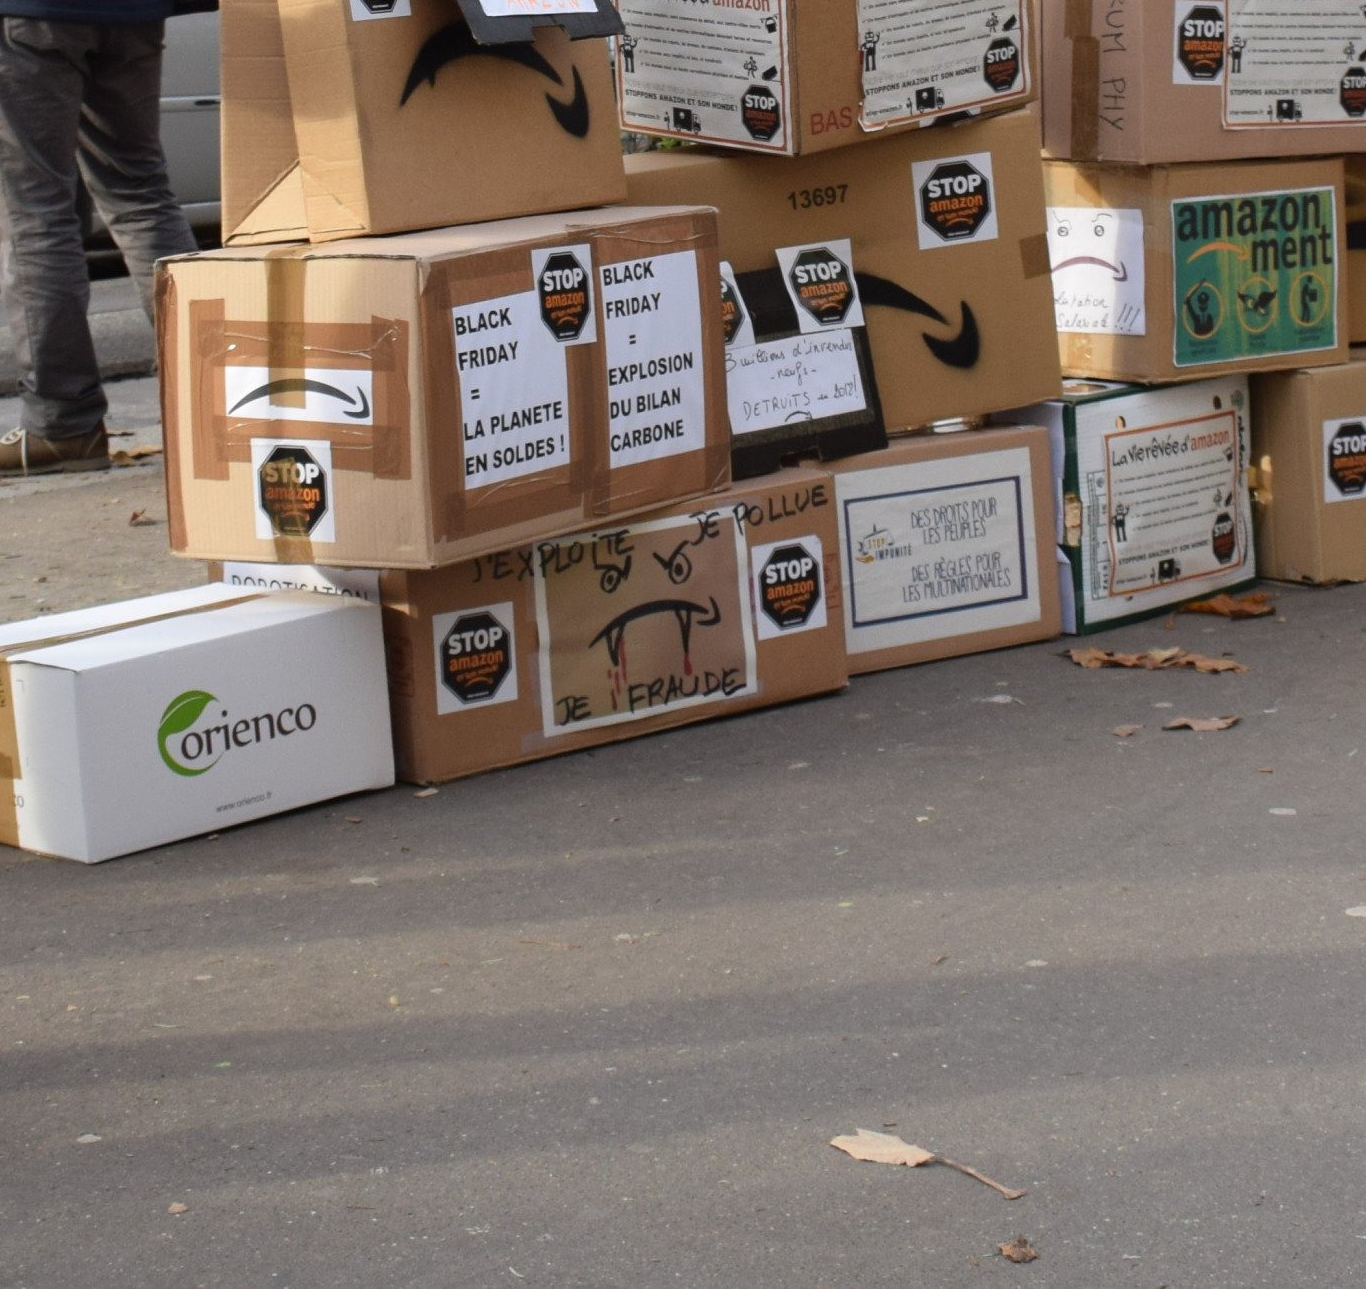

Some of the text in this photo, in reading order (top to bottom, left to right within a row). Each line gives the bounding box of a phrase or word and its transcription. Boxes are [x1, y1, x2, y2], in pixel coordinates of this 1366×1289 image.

[1184, 19, 1224, 38] STOP
[987, 46, 1015, 63] STOP
[745, 95, 775, 110] STOP
[810, 106, 853, 135] BAS
[788, 184, 849, 210] 13697
[927, 174, 981, 198] STOP
[929, 195, 983, 213] amazon
[1177, 194, 1322, 241] amazon
[1250, 224, 1333, 273] ment
[543, 268, 583, 291] STOP
[602, 260, 654, 286] BLACK
[795, 262, 841, 284] STOP
[545, 292, 585, 309] amazon
[800, 282, 848, 298] amazon
[606, 293, 661, 319] FRIDAY
[456, 308, 512, 335] BLACK
[630, 335, 636, 344] =
[459, 342, 518, 370] FRIDAY
[608, 352, 694, 386] EXPLOSION
[471, 389, 480, 400] =
[610, 387, 681, 419] DU BILAN
[464, 401, 563, 441] LA PLANETE
[610, 420, 684, 452] CARBONE
[466, 454, 487, 476] EN
[493, 438, 555, 468] SOLDES
[262, 462, 319, 484] STOP
[266, 488, 320, 501] amazon
[690, 484, 829, 546] JE POLLUE
[911, 497, 997, 529] DES DROITS POUR
[923, 520, 987, 545] LES PEUPLES
[765, 557, 813, 584] STOP
[912, 564, 931, 583] DES
[976, 551, 1001, 573] POUR
[767, 579, 814, 600] amazon
[902, 568, 1011, 603] LES MULTINATIONALES
[448, 627, 502, 655] STOP
[449, 650, 503, 672] amazon
[559, 669, 746, 726] JE FRAUDE
[180, 701, 316, 761] orienco
